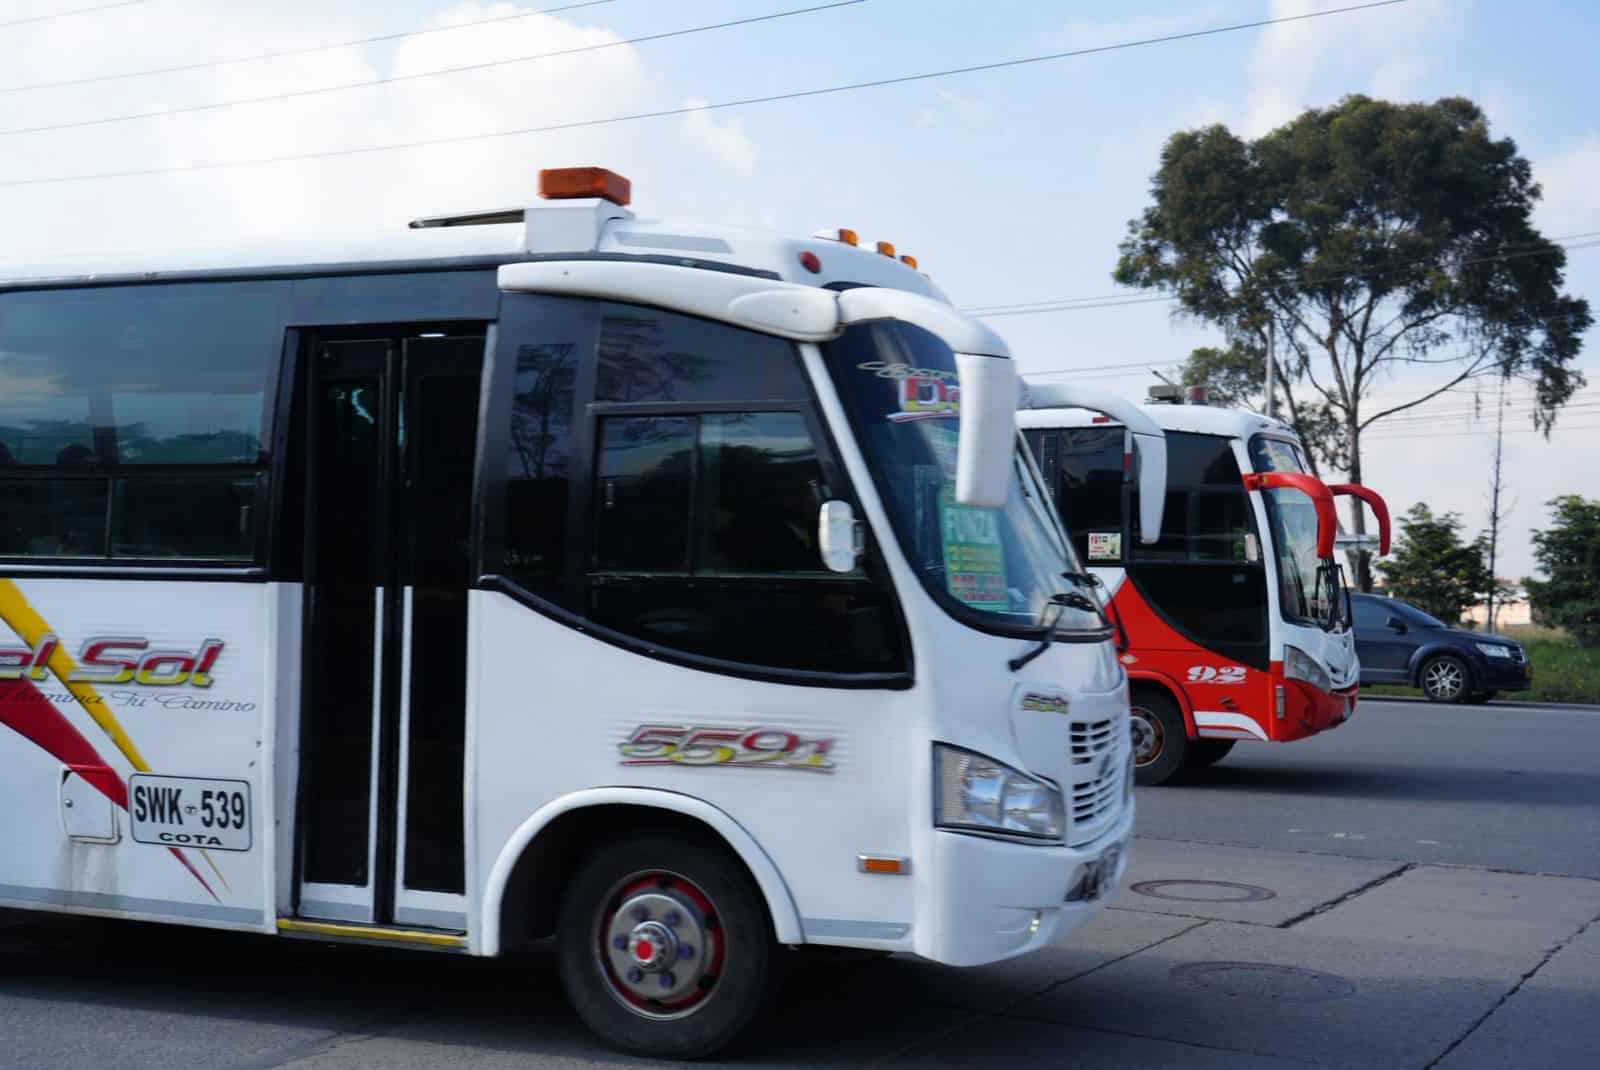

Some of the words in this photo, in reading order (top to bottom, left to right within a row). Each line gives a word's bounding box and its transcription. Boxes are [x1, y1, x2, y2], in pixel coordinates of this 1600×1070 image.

[67, 636, 225, 688] Sol
[1187, 665, 1248, 682] 92
[110, 690, 149, 707] Tu
[153, 692, 256, 712] Camino
[616, 724, 838, 769] 5591
[135, 785, 184, 826] SWK
[201, 790, 245, 830] 539
[159, 832, 223, 846] COTA
